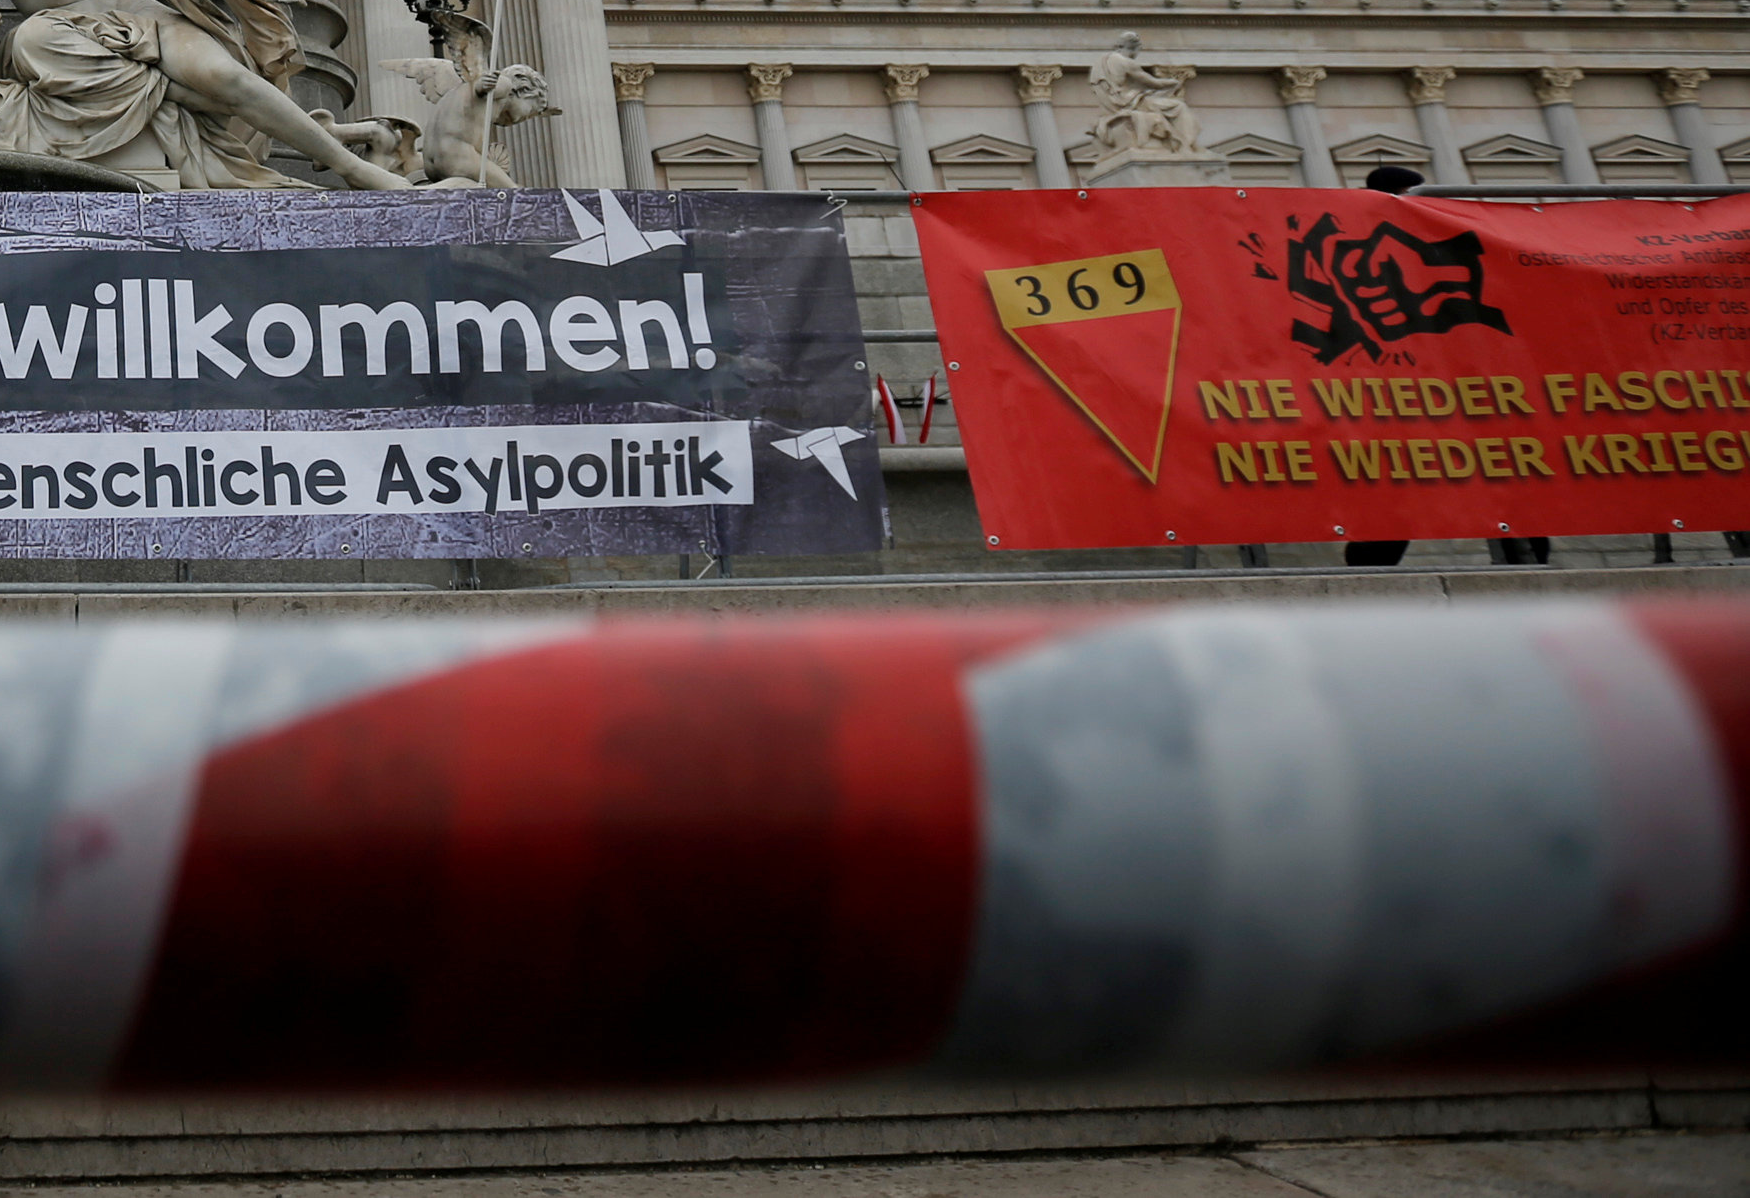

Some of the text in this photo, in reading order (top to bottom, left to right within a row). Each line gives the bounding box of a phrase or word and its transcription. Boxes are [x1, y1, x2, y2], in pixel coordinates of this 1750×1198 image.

[1616, 298, 1653, 315] und
[1660, 297, 1711, 317] Opfer
[1198, 369, 1750, 419] NIE WIEDER FASCHI
[376, 436, 734, 516] Asylpolitik
[1216, 440, 1318, 482] NIE
[1329, 437, 1555, 480] WIEDER
